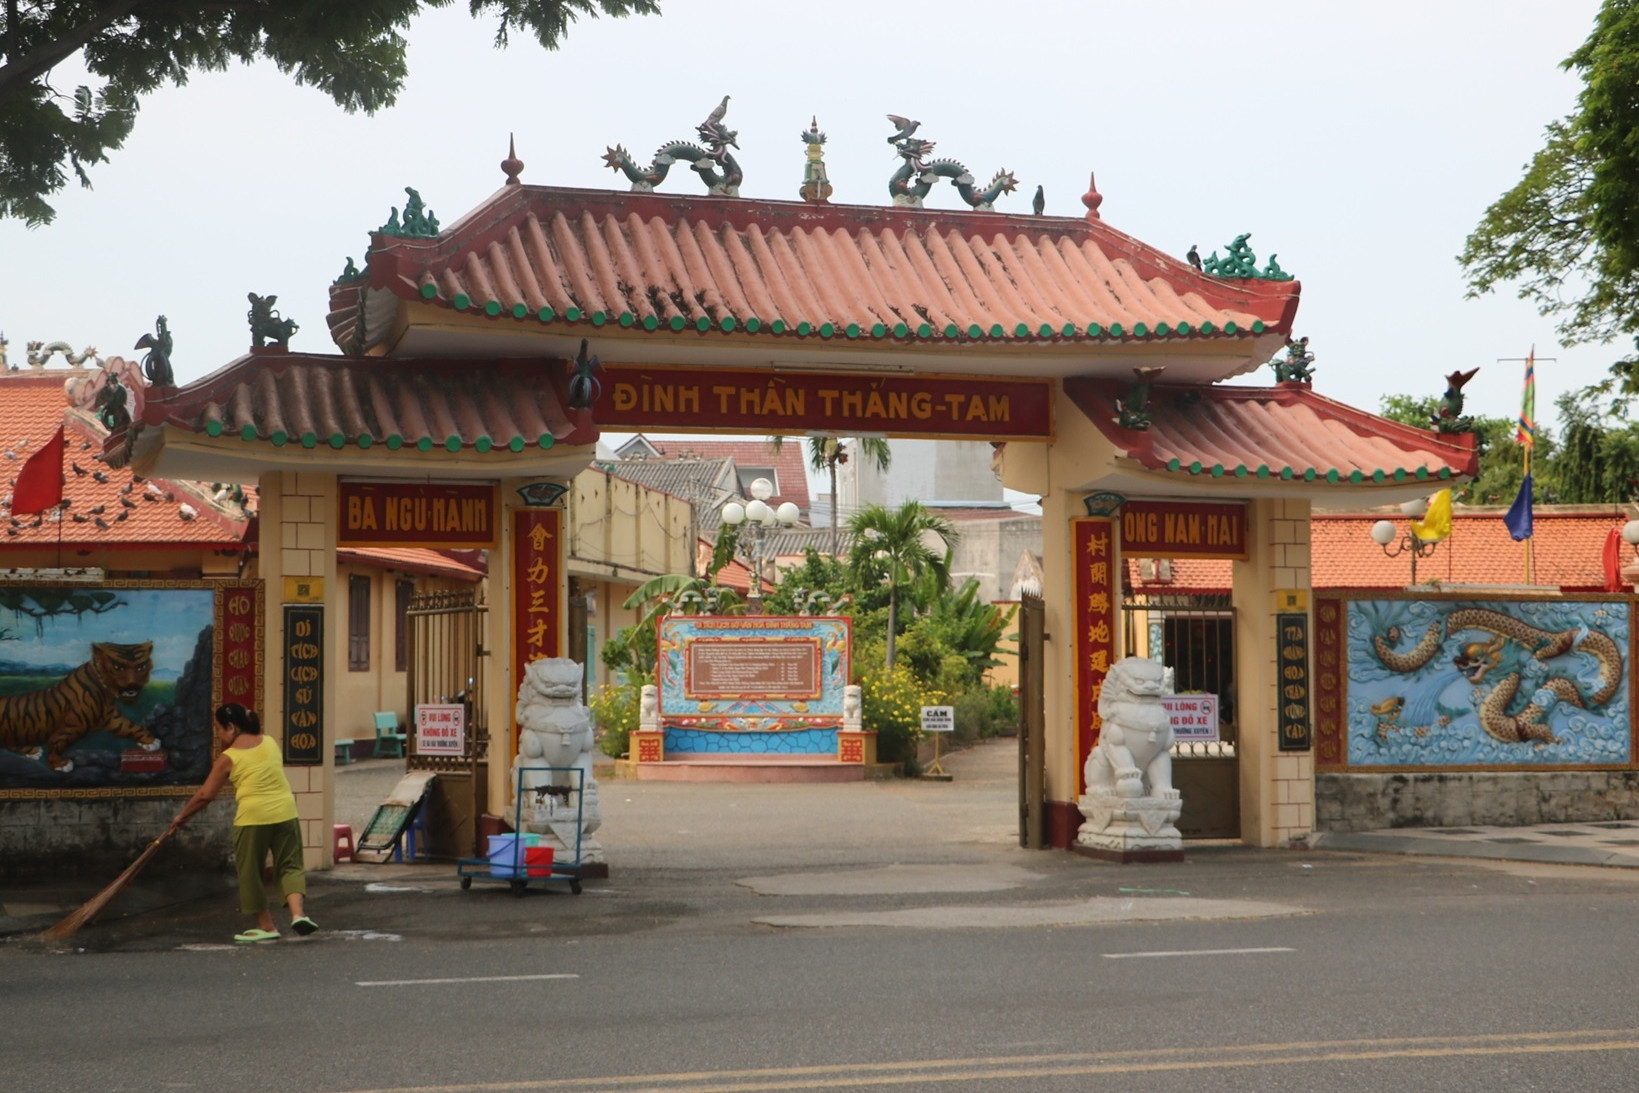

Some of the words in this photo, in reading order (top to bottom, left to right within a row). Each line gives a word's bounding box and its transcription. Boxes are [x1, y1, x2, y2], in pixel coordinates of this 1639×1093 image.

[612, 375, 699, 412] ĐÌNH
[713, 377, 805, 416] THẦN
[1197, 716, 1208, 725] XE
